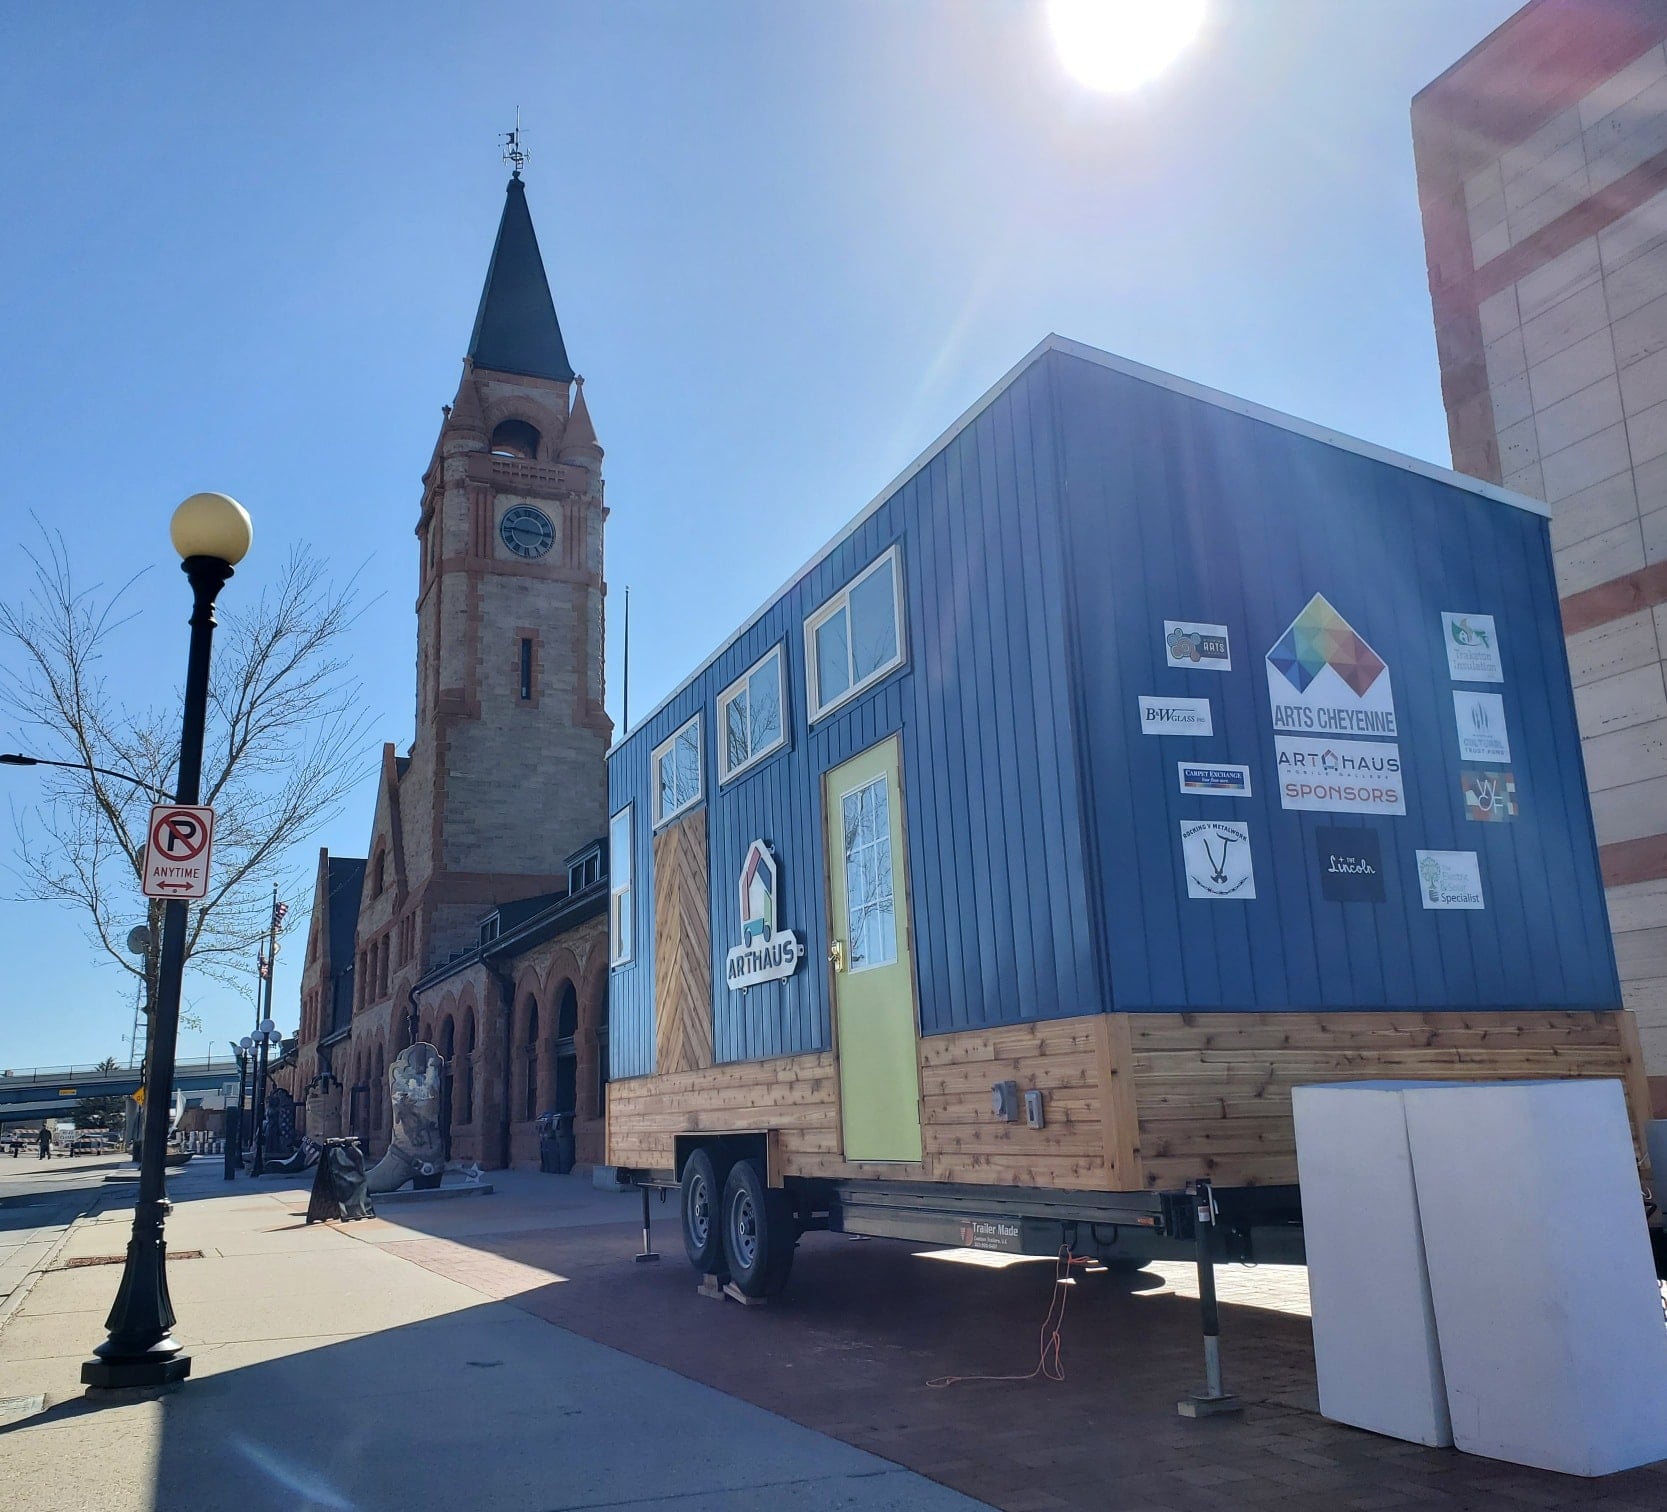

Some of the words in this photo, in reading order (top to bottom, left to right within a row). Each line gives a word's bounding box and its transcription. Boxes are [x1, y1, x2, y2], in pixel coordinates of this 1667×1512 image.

[1203, 641, 1225, 653] ARTS
[1274, 704, 1314, 728] ARTS
[1316, 707, 1396, 733] CHEYENNE
[1185, 769, 1209, 778] CARPET
[1209, 771, 1242, 780] EXCHANGE
[1285, 783, 1399, 803] SPONSORS
[1182, 823, 1207, 839] ROCKING
[1327, 855, 1376, 874] Lincoln
[153, 866, 201, 879] ANYTIME
[1440, 892, 1480, 904] Specialist
[728, 940, 794, 980] ARTHAUS
[972, 1222, 997, 1235] Trailer
[997, 1224, 1019, 1237] Made
